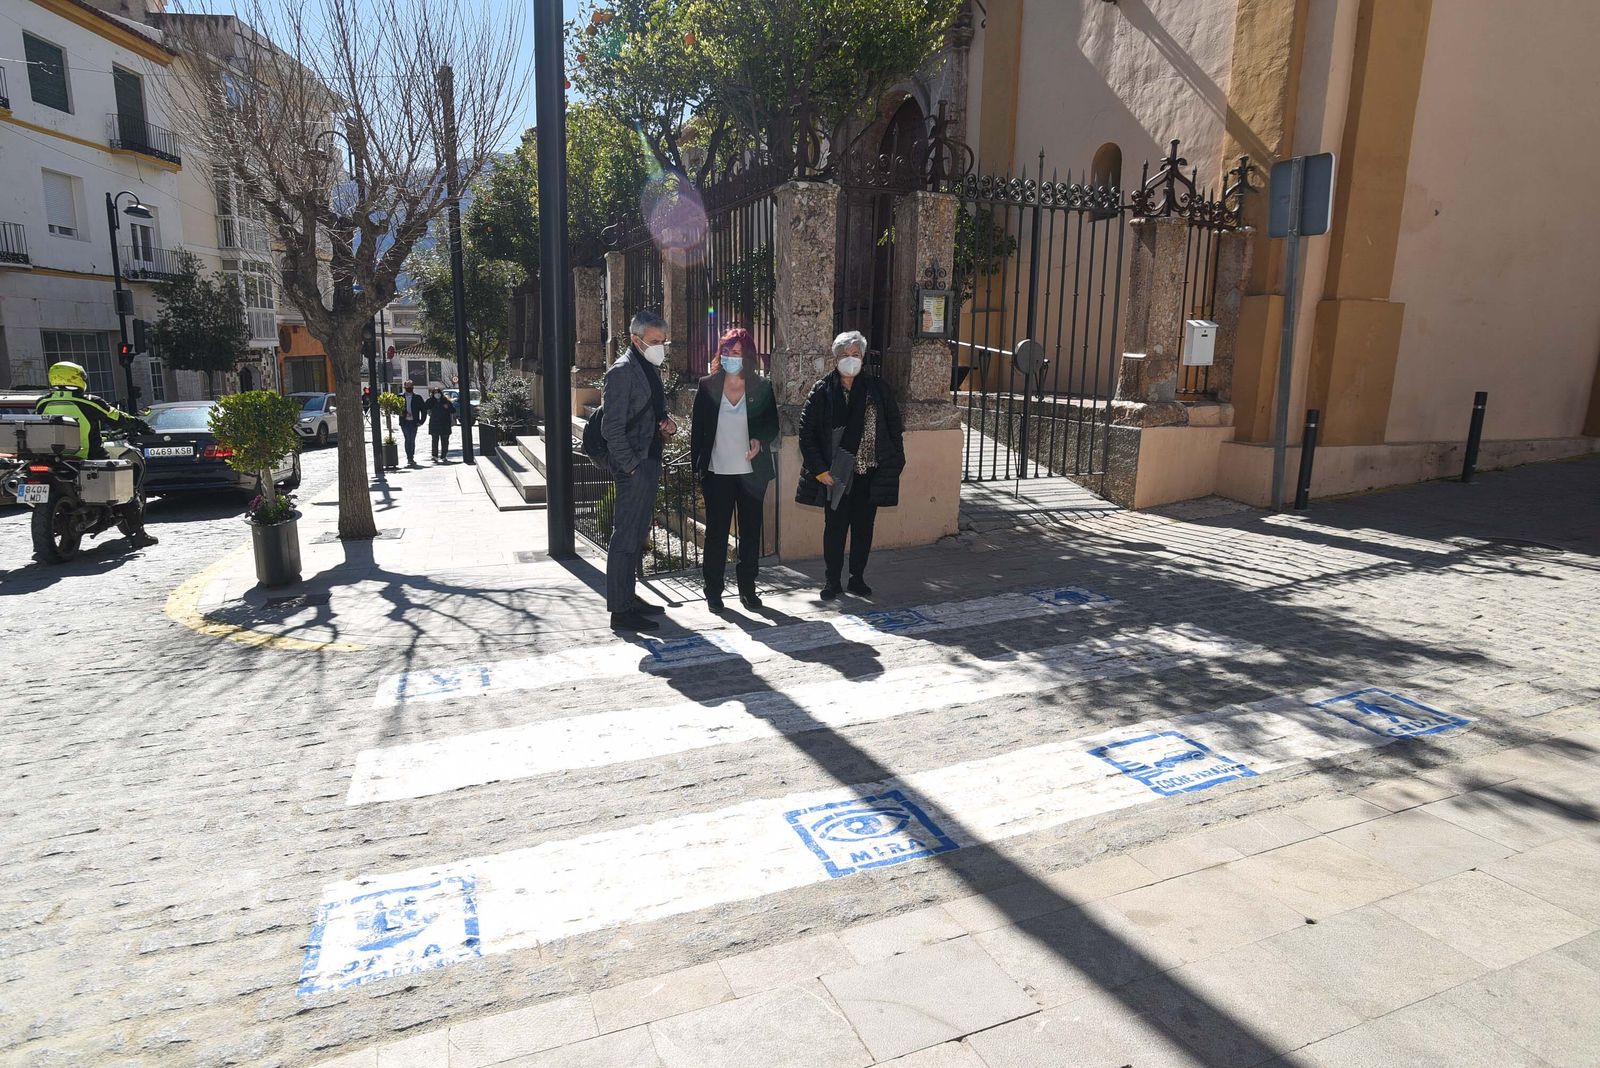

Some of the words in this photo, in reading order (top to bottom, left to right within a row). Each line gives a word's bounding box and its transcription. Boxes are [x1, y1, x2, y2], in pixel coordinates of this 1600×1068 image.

[149, 447, 172, 456] 0469
[174, 447, 192, 455] KSB
[25, 485, 48, 494] 8404
[24, 494, 41, 503] LMD
[1156, 774, 1194, 789] COCHE
[850, 838, 925, 863] MIRA
